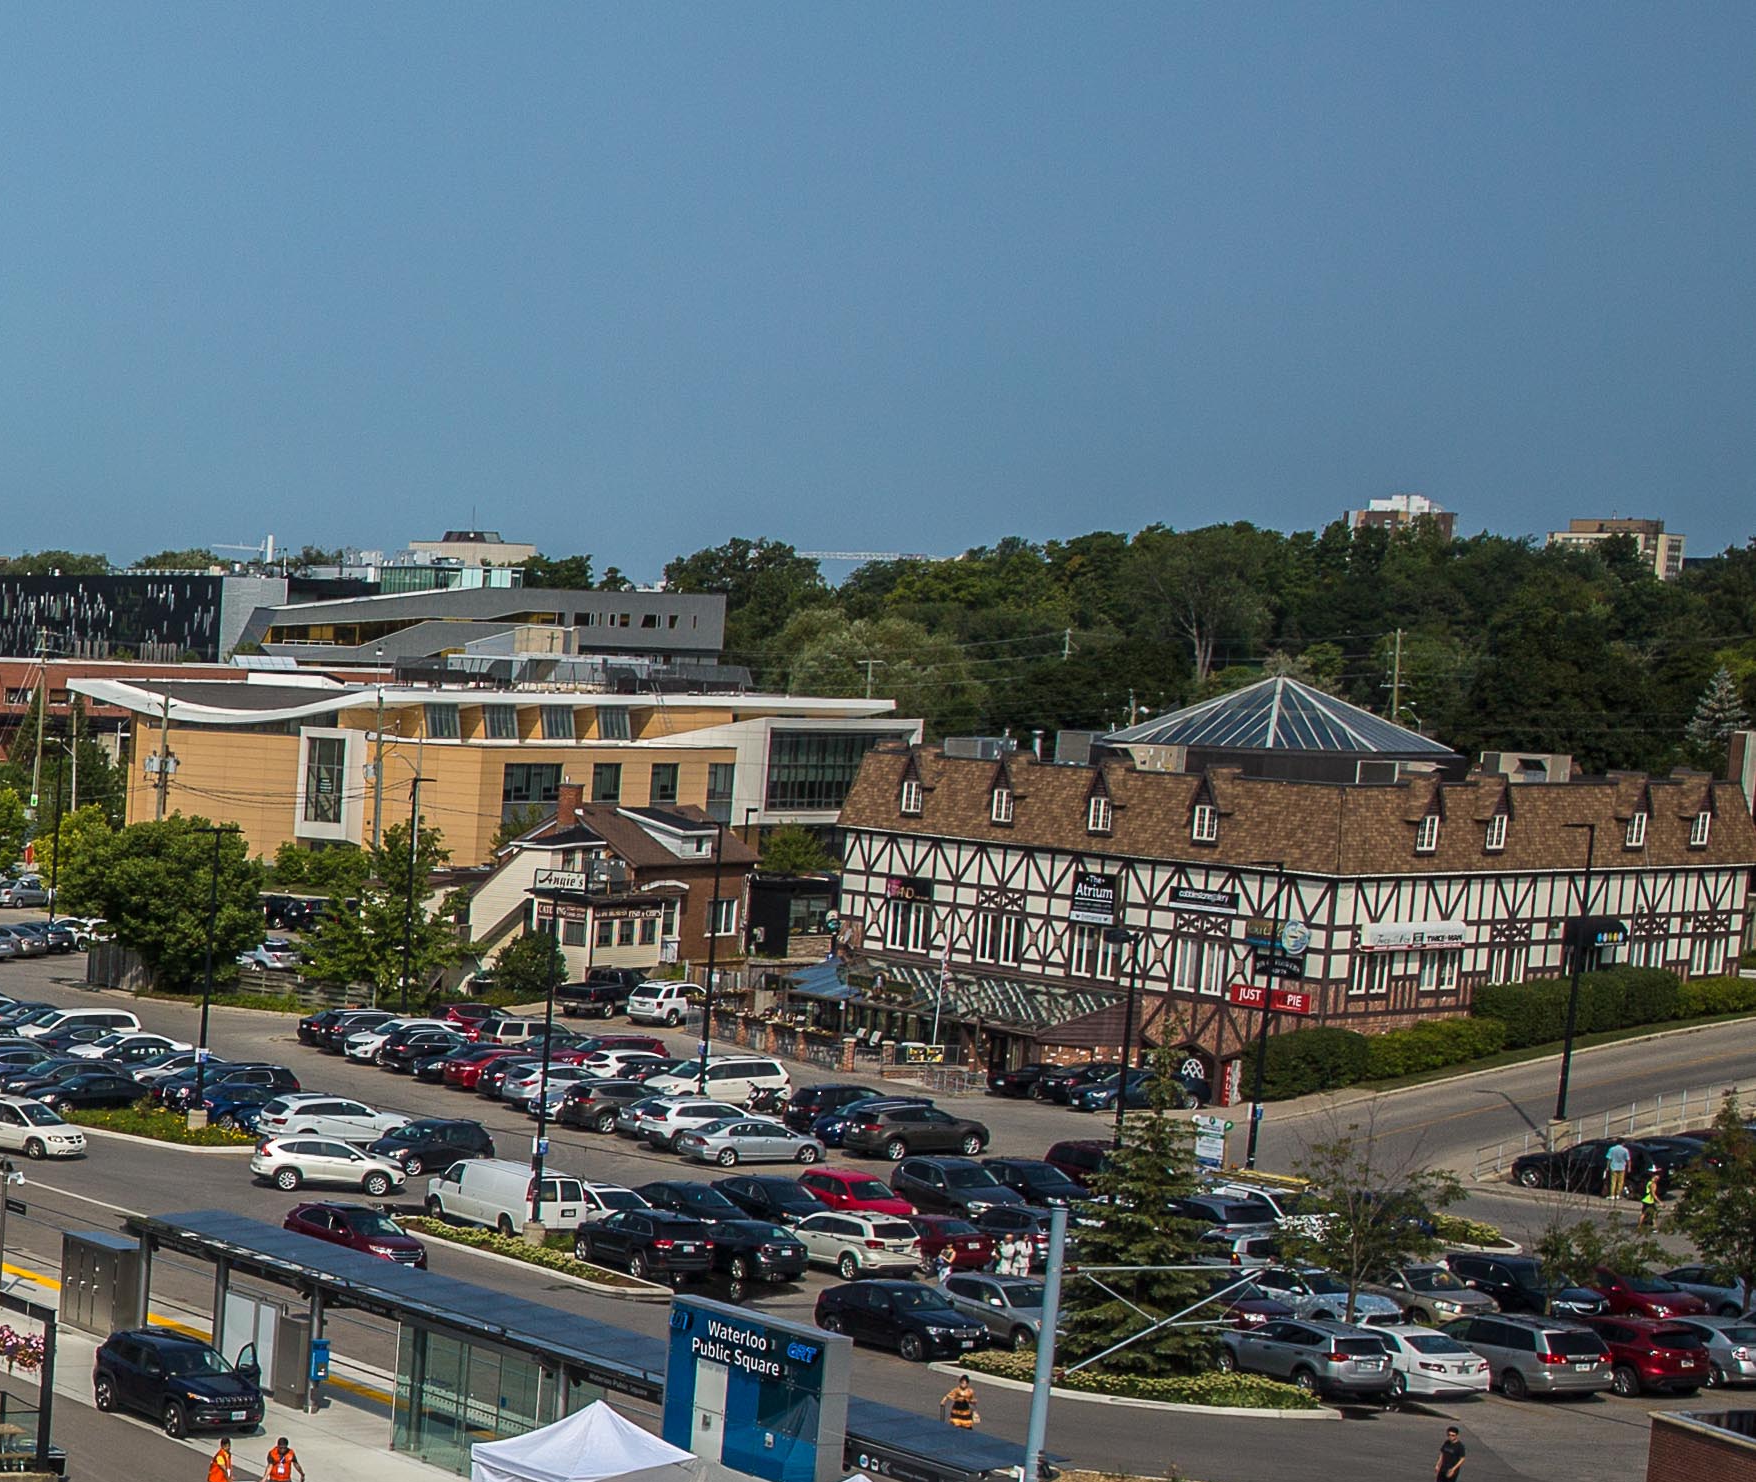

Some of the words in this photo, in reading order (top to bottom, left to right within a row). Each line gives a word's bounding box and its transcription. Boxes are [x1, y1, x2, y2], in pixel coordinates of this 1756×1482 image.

[538, 872, 583, 888] Angie's
[1076, 883, 1113, 900] Atrium
[1239, 987, 1262, 1001] JUST
[1287, 994, 1302, 1007] PIE
[708, 1319, 767, 1351] Waterloo
[691, 1337, 731, 1363] Public
[734, 1349, 780, 1376] Square
